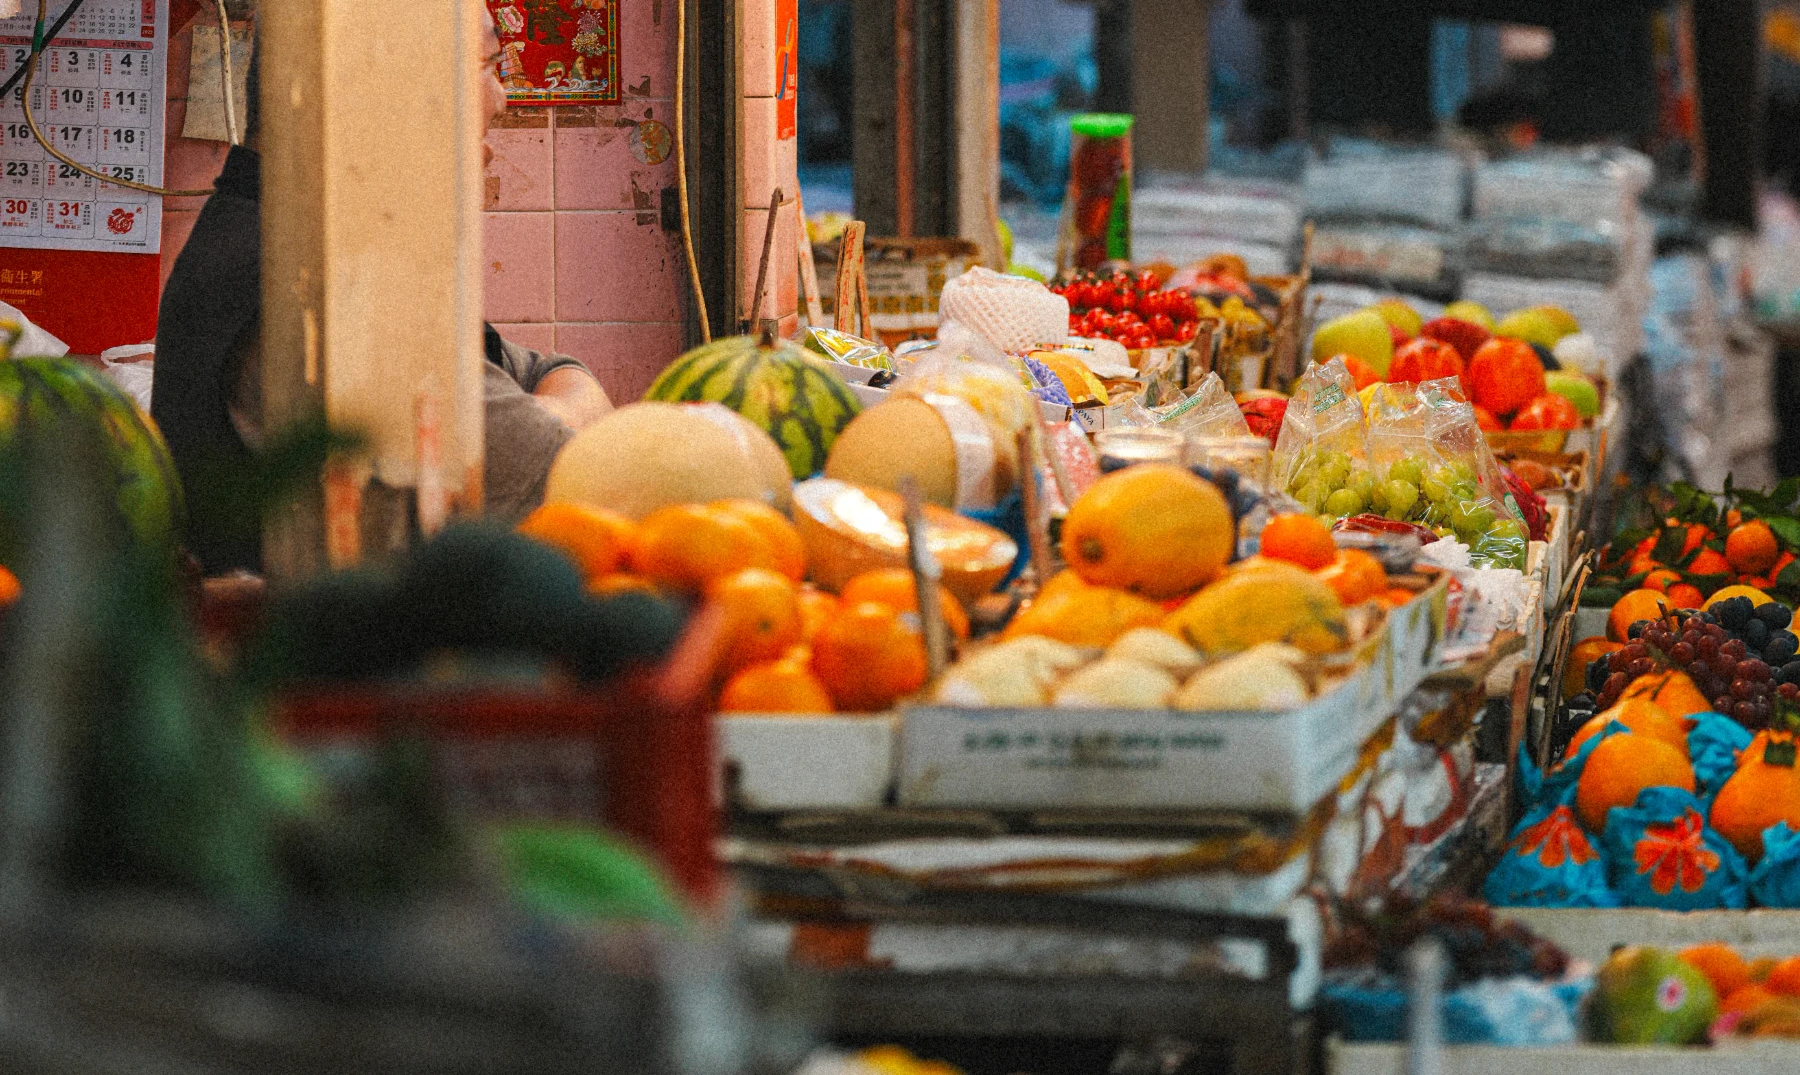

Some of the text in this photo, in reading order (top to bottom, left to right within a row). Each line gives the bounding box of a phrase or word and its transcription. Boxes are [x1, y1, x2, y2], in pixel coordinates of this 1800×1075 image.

[15, 49, 26, 63] 2
[68, 51, 79, 65] 3
[120, 53, 132, 67] 4
[14, 87, 23, 101] 9
[62, 89, 83, 103] 10
[115, 91, 135, 105] 11
[7, 124, 29, 139] 16
[60, 127, 82, 141] 17
[113, 129, 135, 143] 18
[6, 162, 29, 176] 23
[59, 164, 82, 179] 24
[112, 167, 134, 181] 25
[5, 199, 27, 214] 30
[59, 202, 79, 217] 31
